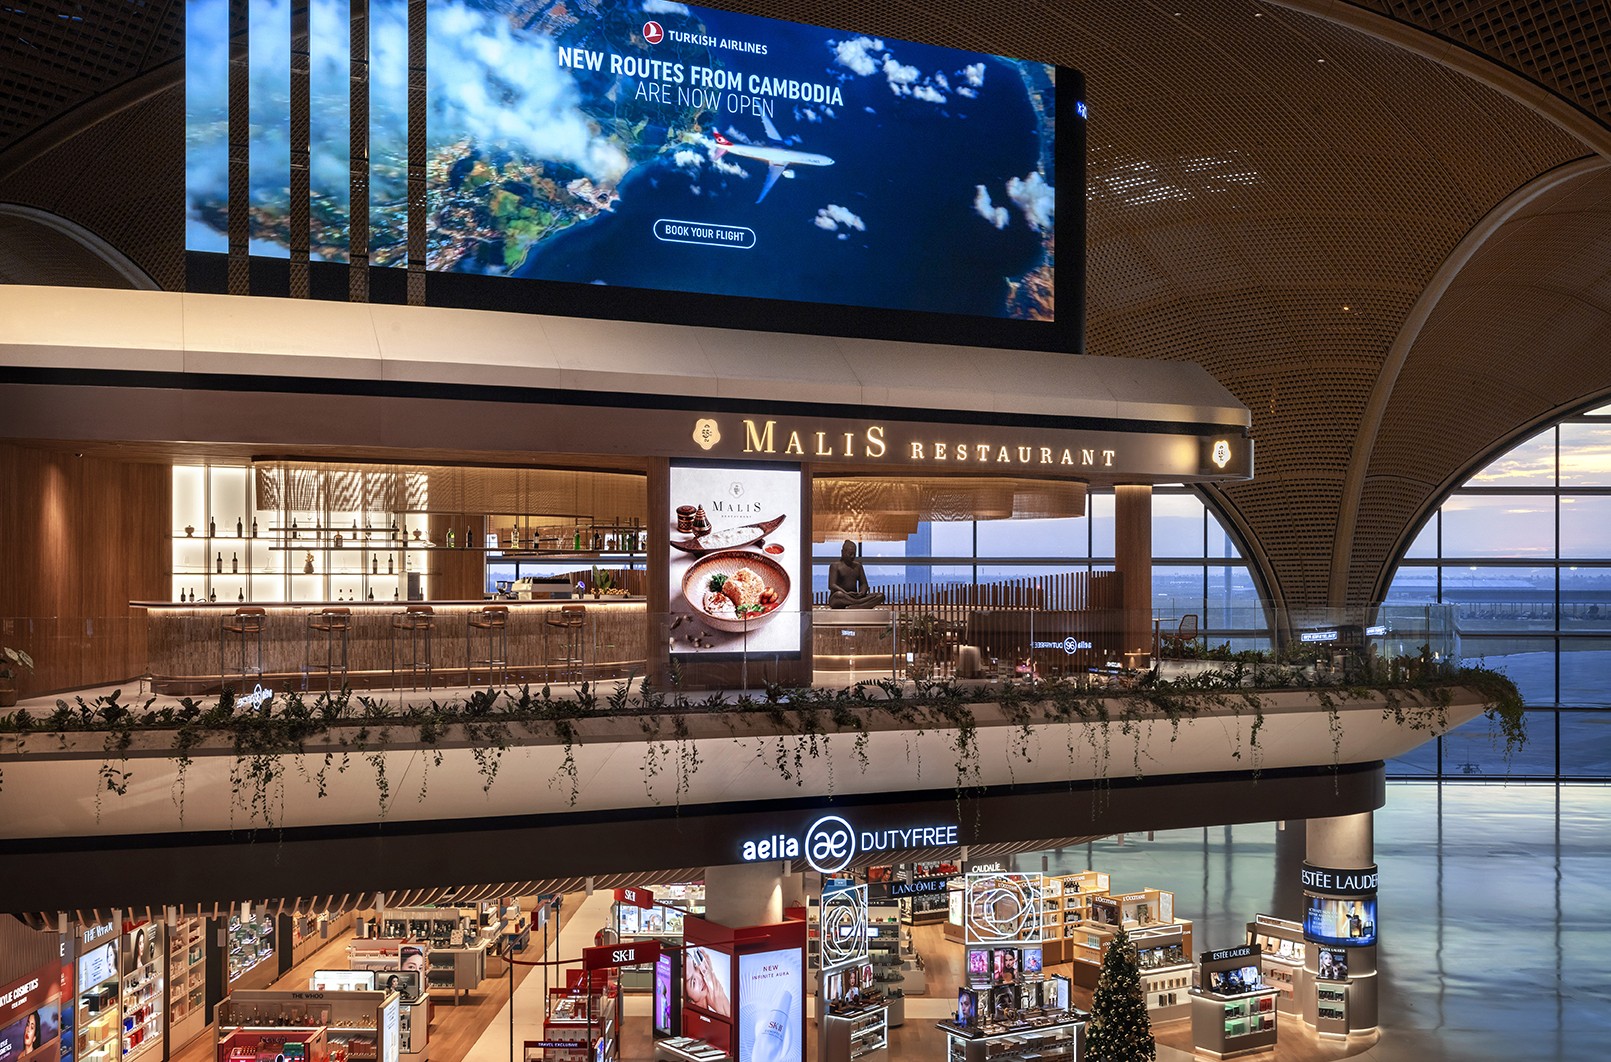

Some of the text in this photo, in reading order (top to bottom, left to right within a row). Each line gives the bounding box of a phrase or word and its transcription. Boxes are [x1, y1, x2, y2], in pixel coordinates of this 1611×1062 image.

[668, 30, 768, 55] TURKISH AIRLINES
[558, 46, 844, 106] NEW ROUTES FROM CAMBODIA
[635, 81, 774, 118] ARE NOW OPEN
[665, 224, 744, 242] BOOK YOUR FLIGHT
[742, 419, 1115, 466] MALIS RESTAURANT
[712, 500, 762, 512] MALIS
[742, 834, 799, 861] aelia
[860, 826, 958, 851] DUTYFREE
[892, 880, 936, 895] LANCÔME
[612, 948, 635, 963] SK-II
